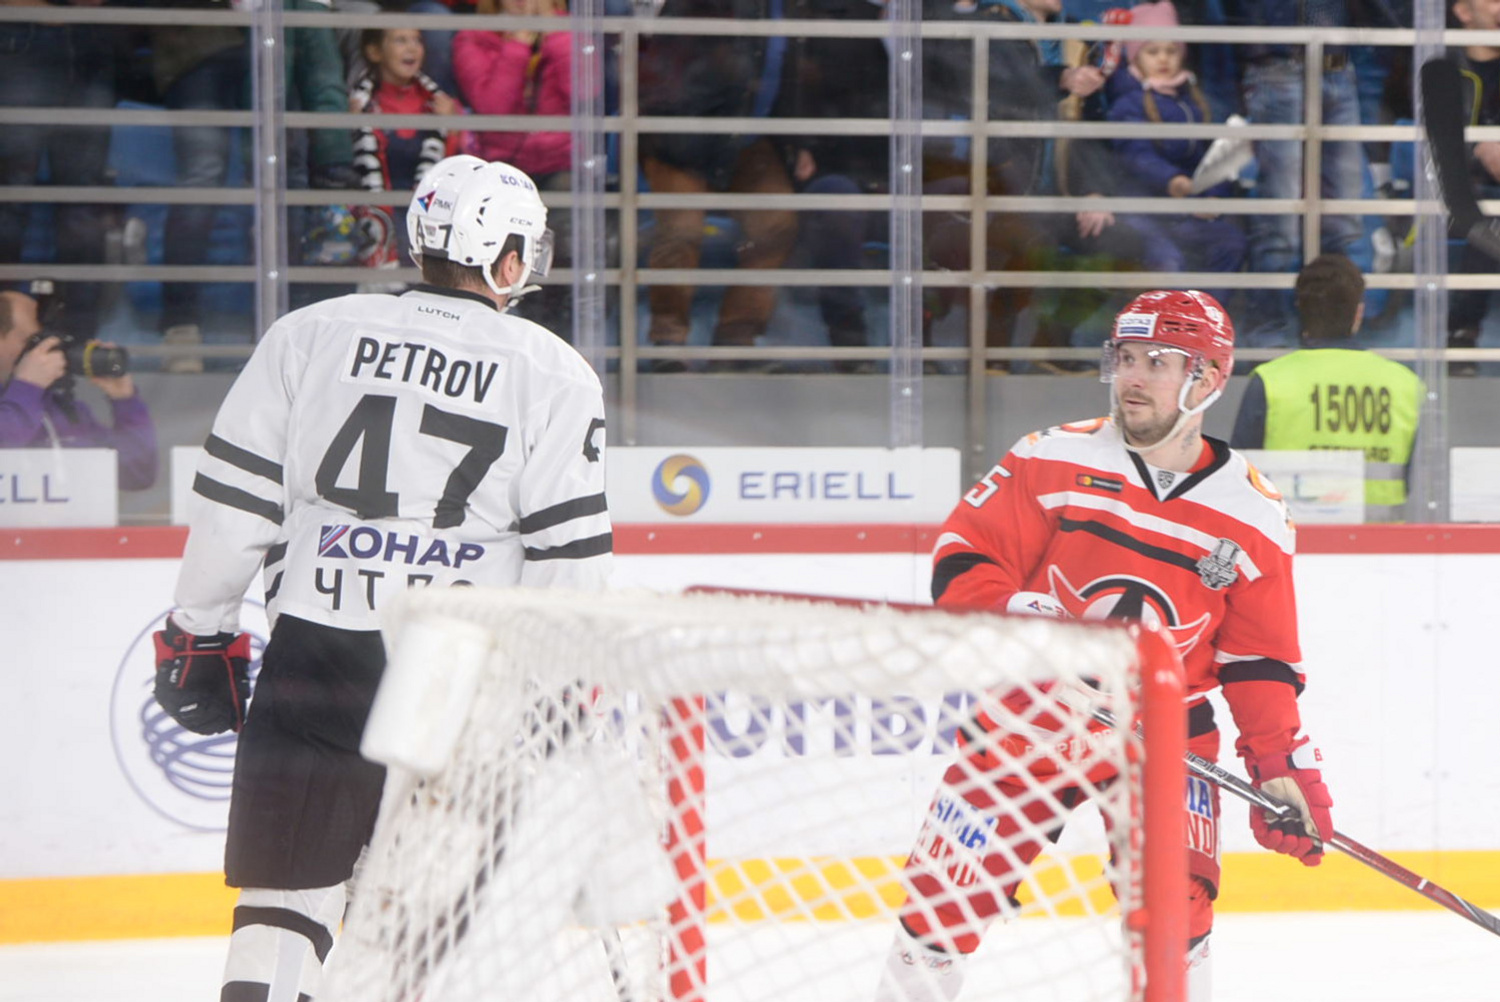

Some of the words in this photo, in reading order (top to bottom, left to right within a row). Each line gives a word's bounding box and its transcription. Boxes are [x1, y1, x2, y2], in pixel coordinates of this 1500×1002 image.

[418, 306, 460, 321] LUTCH
[350, 336, 498, 403] PETROV
[1310, 384, 1391, 434] 15008
[314, 393, 509, 529] 47
[739, 472, 914, 499] ERIELL
[317, 524, 485, 569] КОНАР
[314, 567, 474, 611] ЧТ
